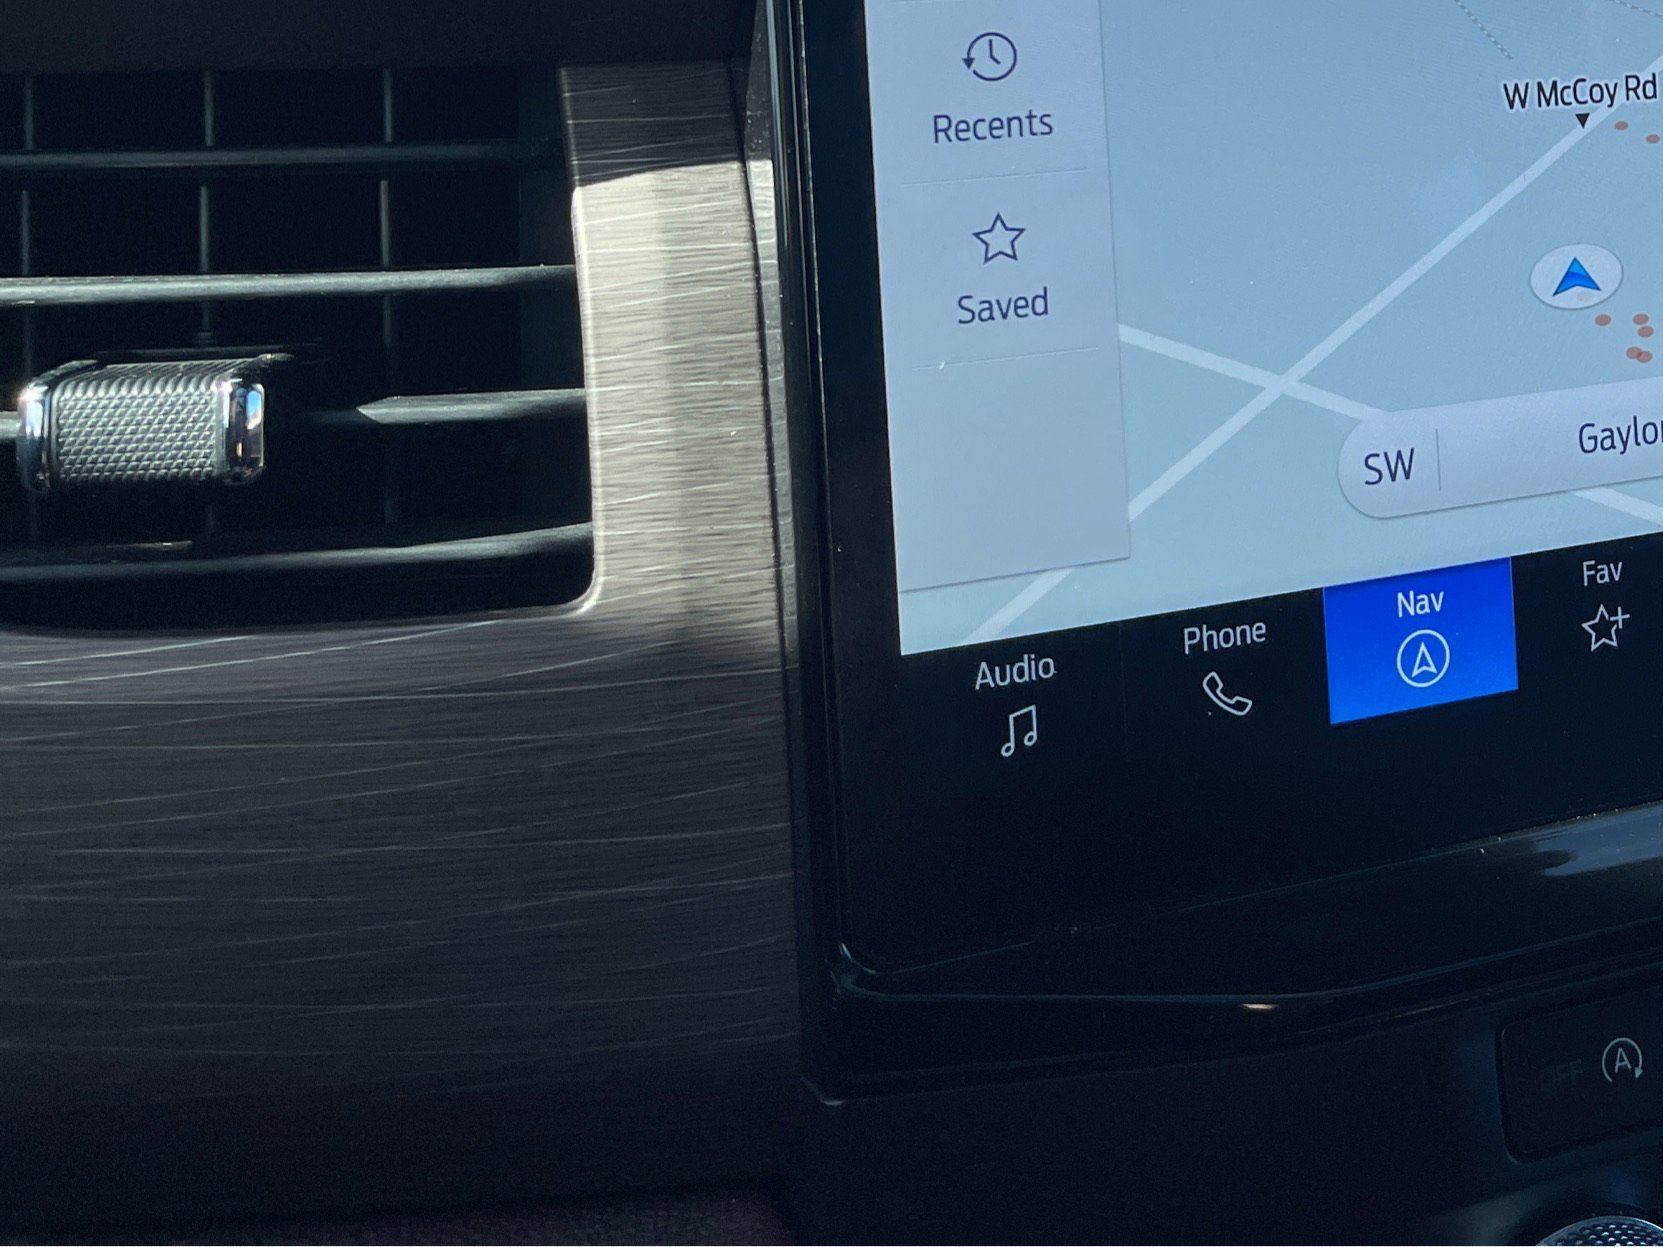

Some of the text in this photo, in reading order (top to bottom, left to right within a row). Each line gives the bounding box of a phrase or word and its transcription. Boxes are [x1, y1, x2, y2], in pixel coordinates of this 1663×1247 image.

[1503, 72, 1658, 110] W McCoy Rd
[933, 110, 1053, 143] Recents
[958, 286, 1049, 324] Saved
[1364, 447, 1414, 486] SW
[1582, 560, 1623, 587] Fav
[1397, 589, 1445, 618] Nav
[1183, 619, 1267, 655] Phone
[975, 654, 1055, 690] Audio
